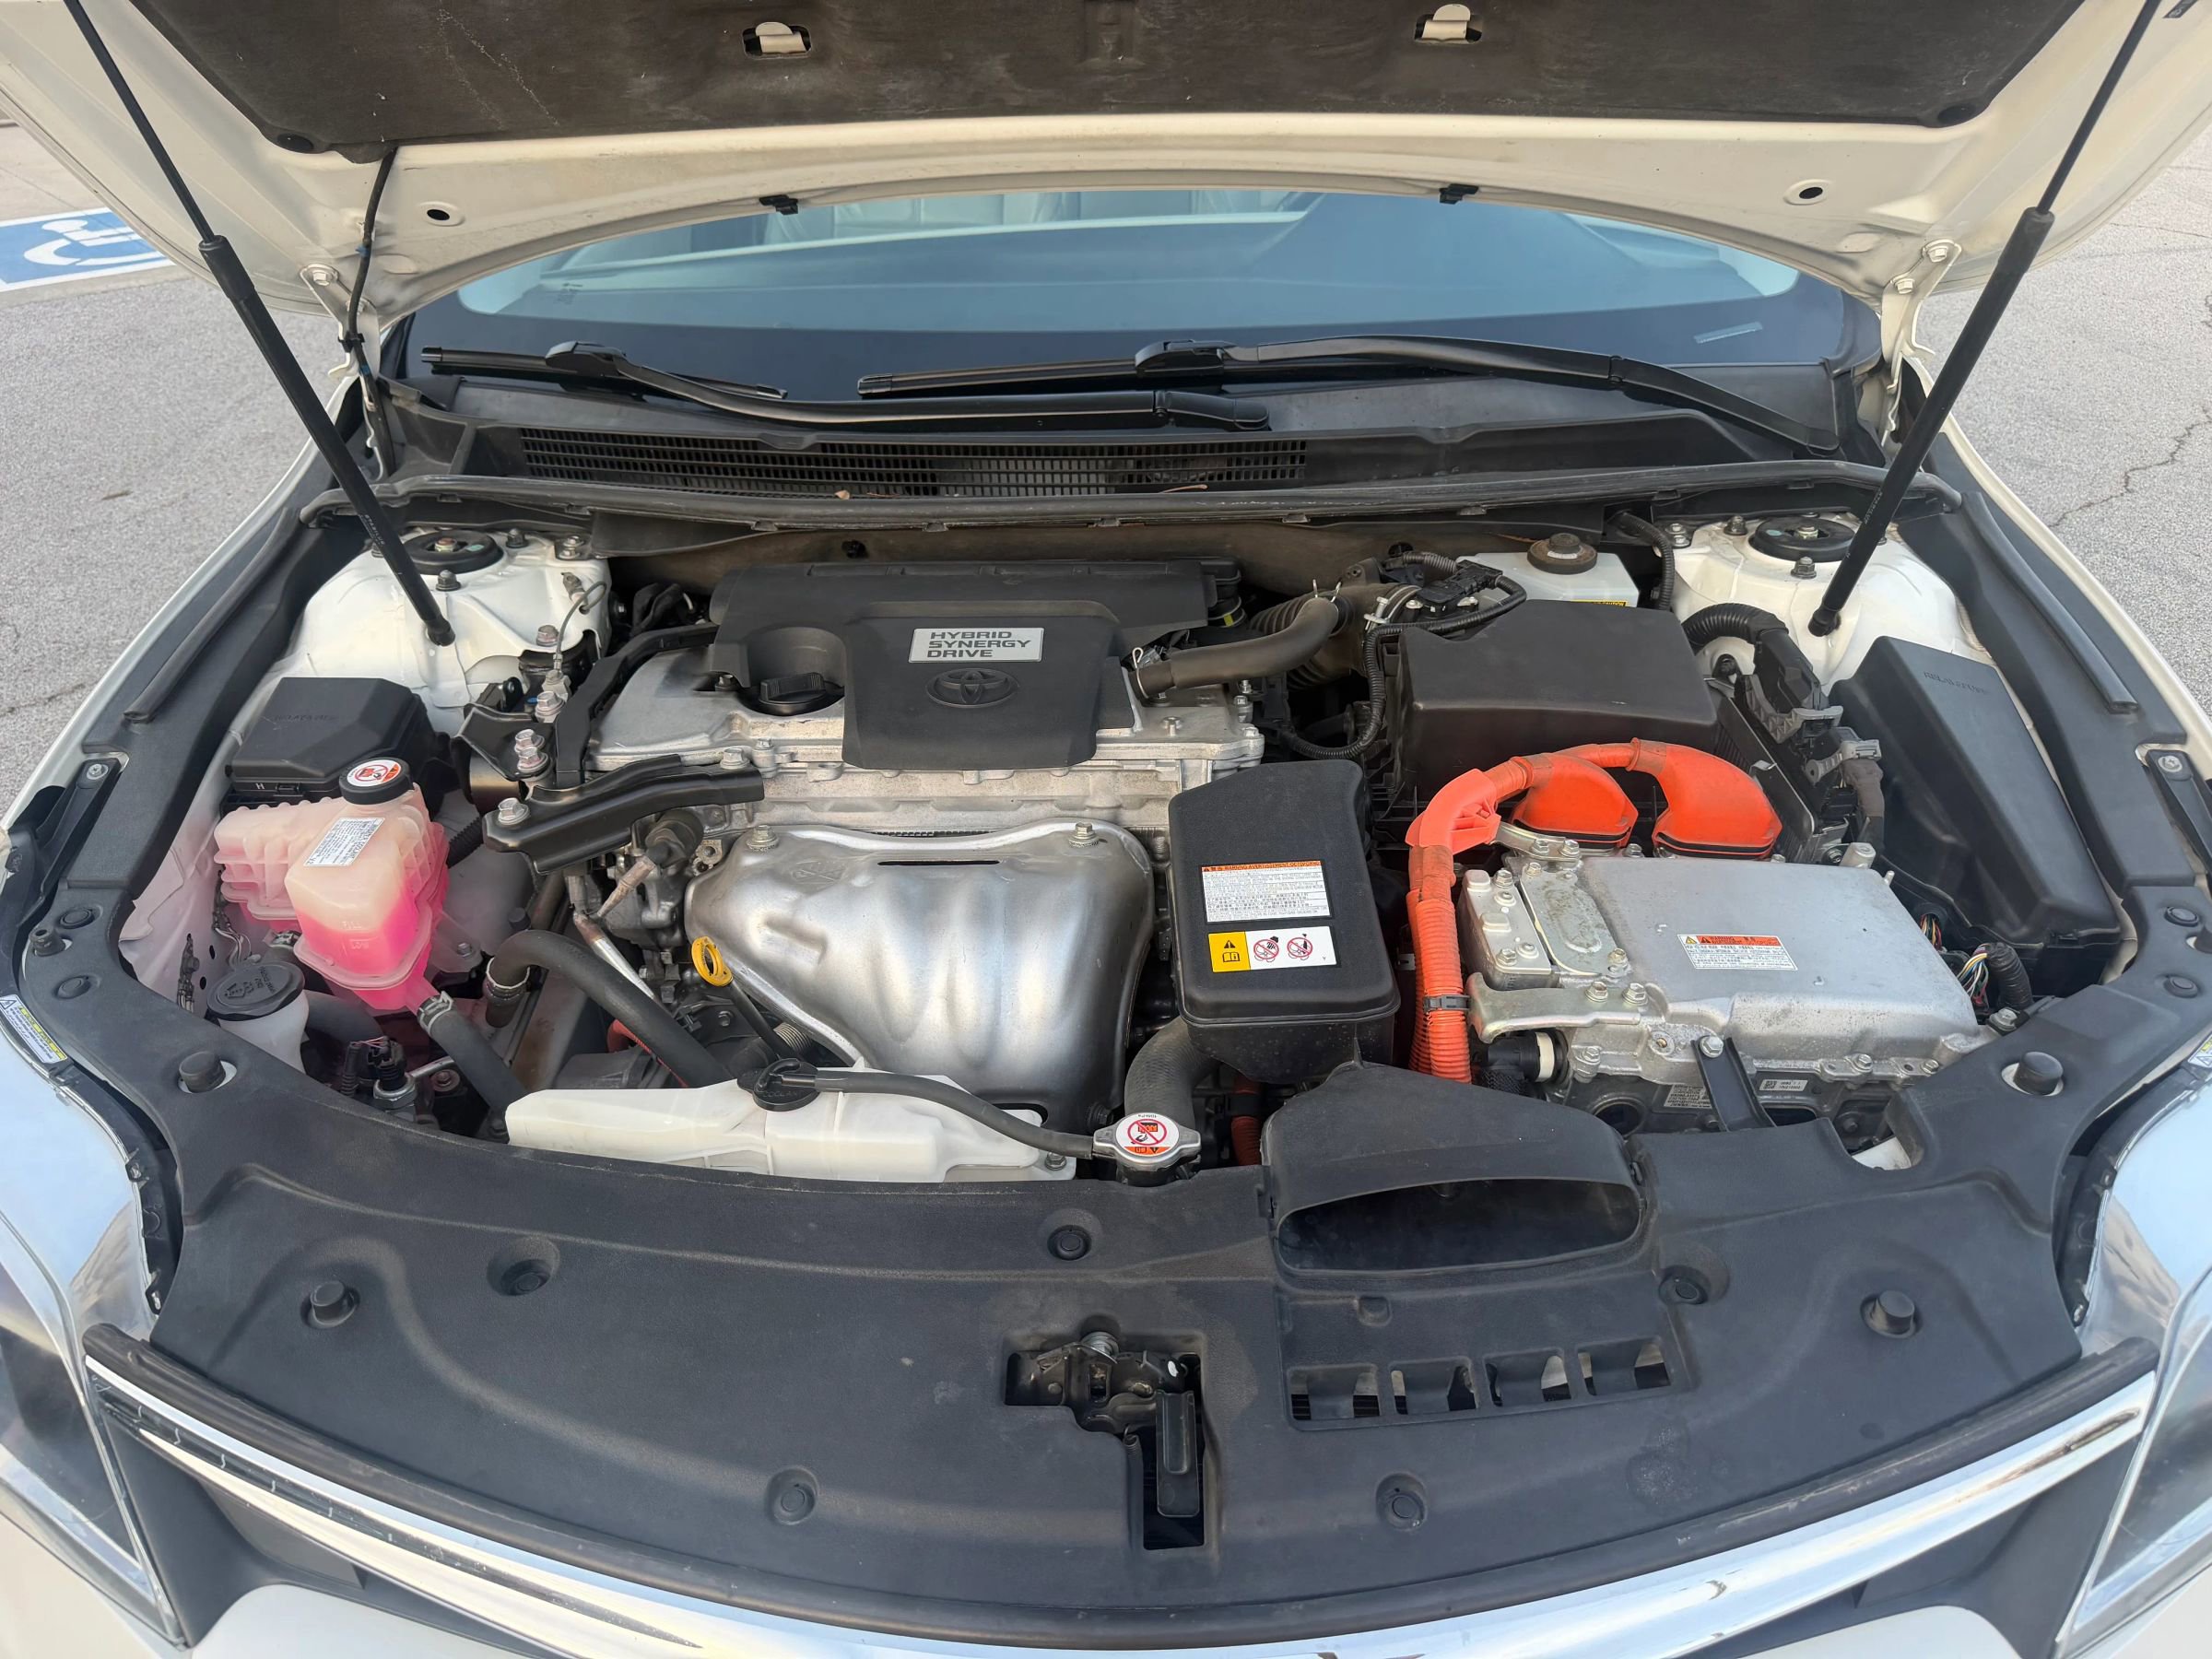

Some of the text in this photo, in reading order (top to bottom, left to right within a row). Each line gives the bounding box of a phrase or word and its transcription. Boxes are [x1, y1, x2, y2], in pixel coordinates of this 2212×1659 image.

[930, 631, 1012, 640] HYBRID
[928, 640, 1031, 649] SYNERGY
[927, 649, 994, 658] DRIVE
